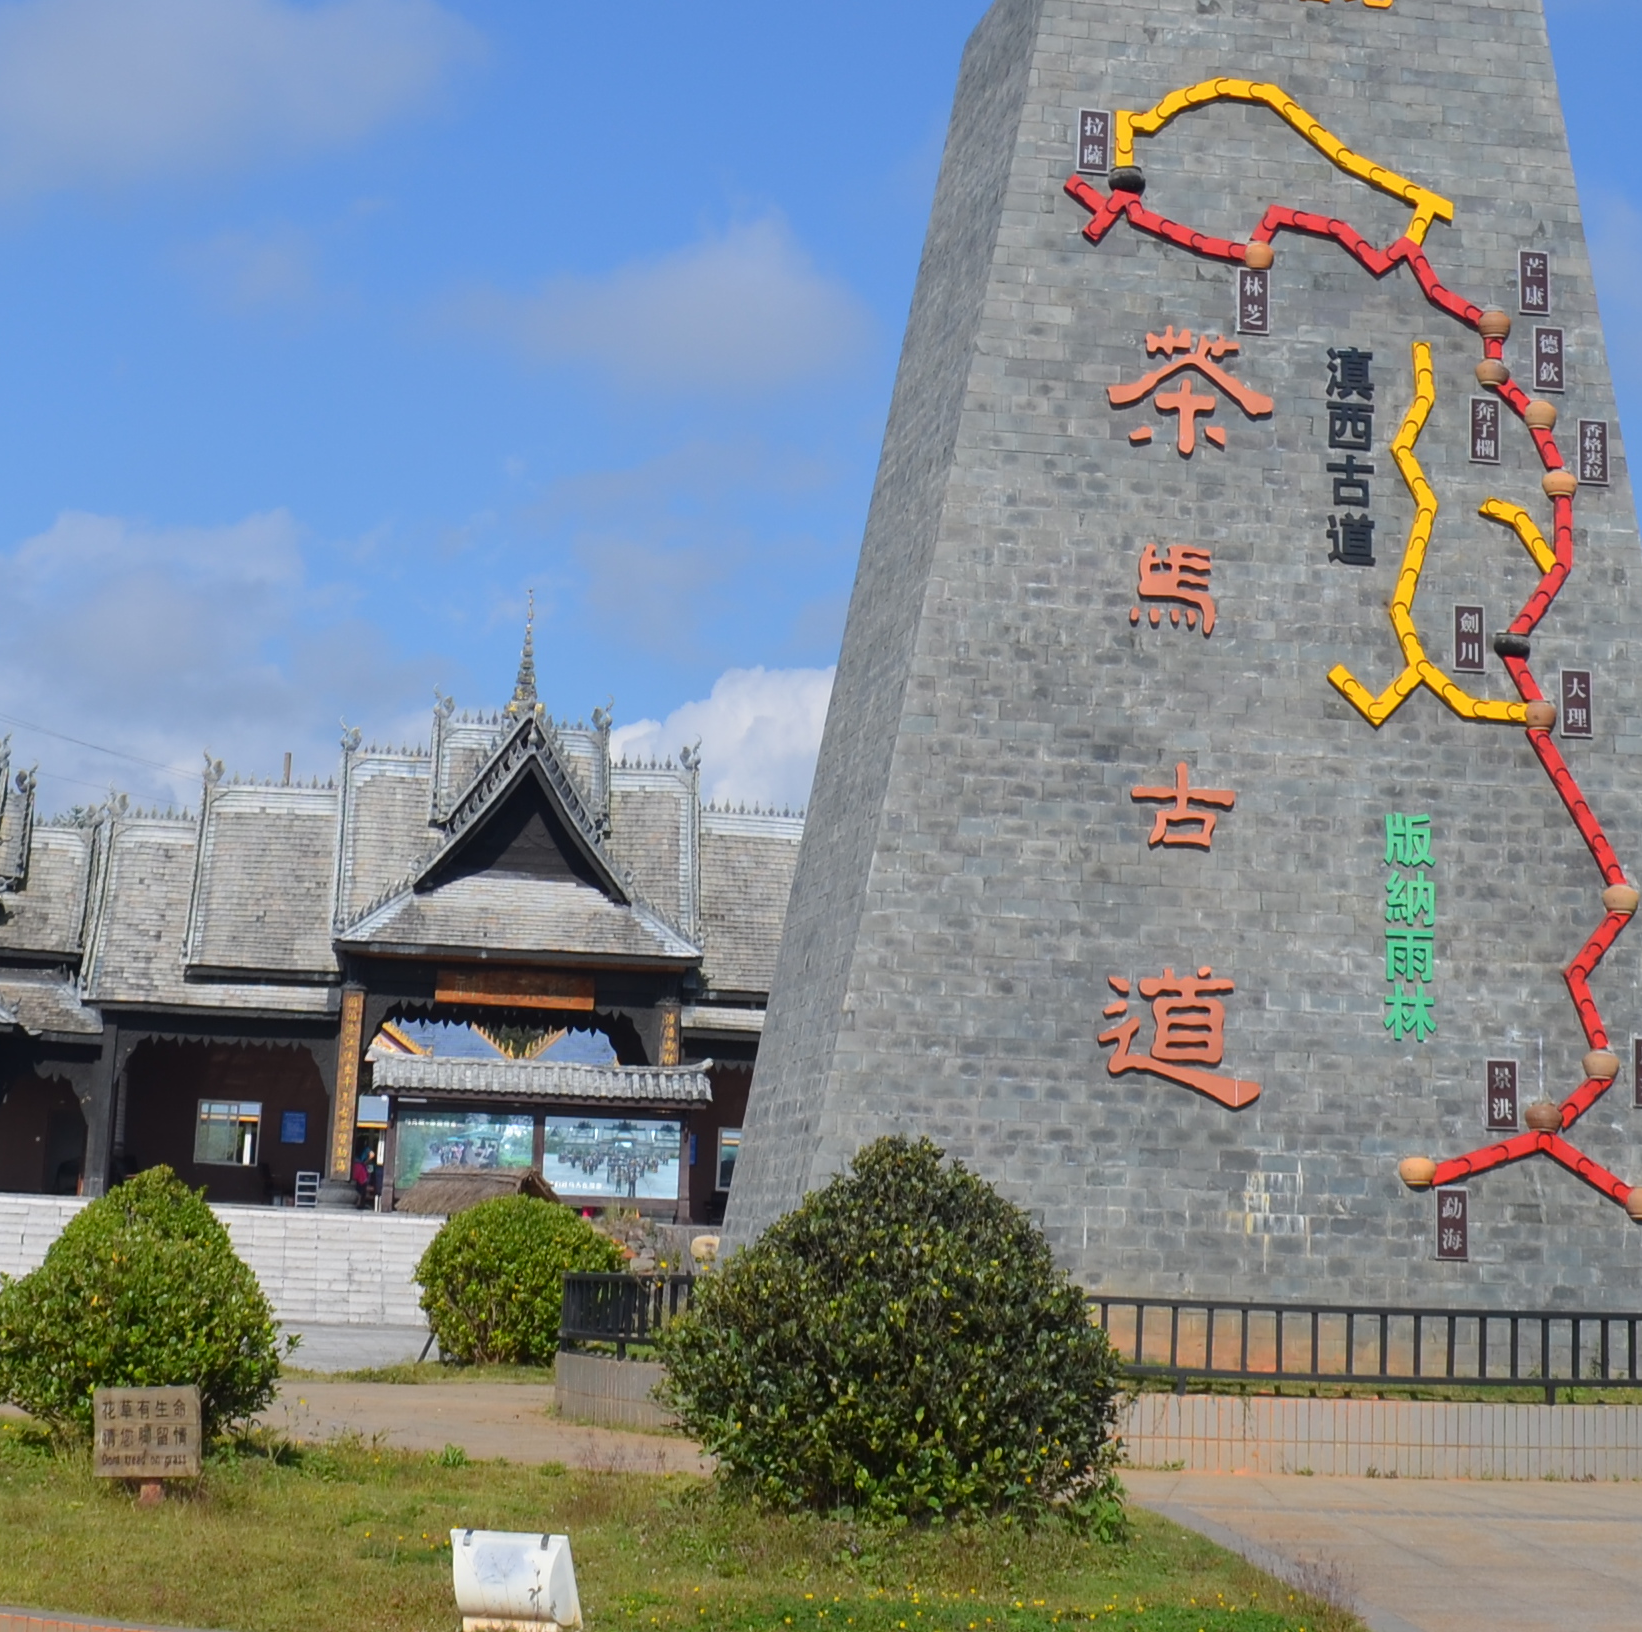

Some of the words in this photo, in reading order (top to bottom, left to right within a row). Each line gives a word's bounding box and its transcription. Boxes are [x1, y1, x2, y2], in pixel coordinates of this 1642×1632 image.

[1083, 115, 1105, 166] 拉薩
[1243, 275, 1264, 326] 林芝
[1524, 257, 1545, 307] 芒康
[1539, 333, 1559, 383] 德欽
[1325, 345, 1376, 567] 滇西古道
[1097, 325, 1274, 1109] 茶馬古道
[1566, 676, 1588, 728] 大理
[1383, 811, 1437, 1042] 版納雨林
[1491, 1066, 1513, 1121] 景洪
[1441, 1195, 1463, 1251] 勐海
[101, 1399, 187, 1419] 花草有生命
